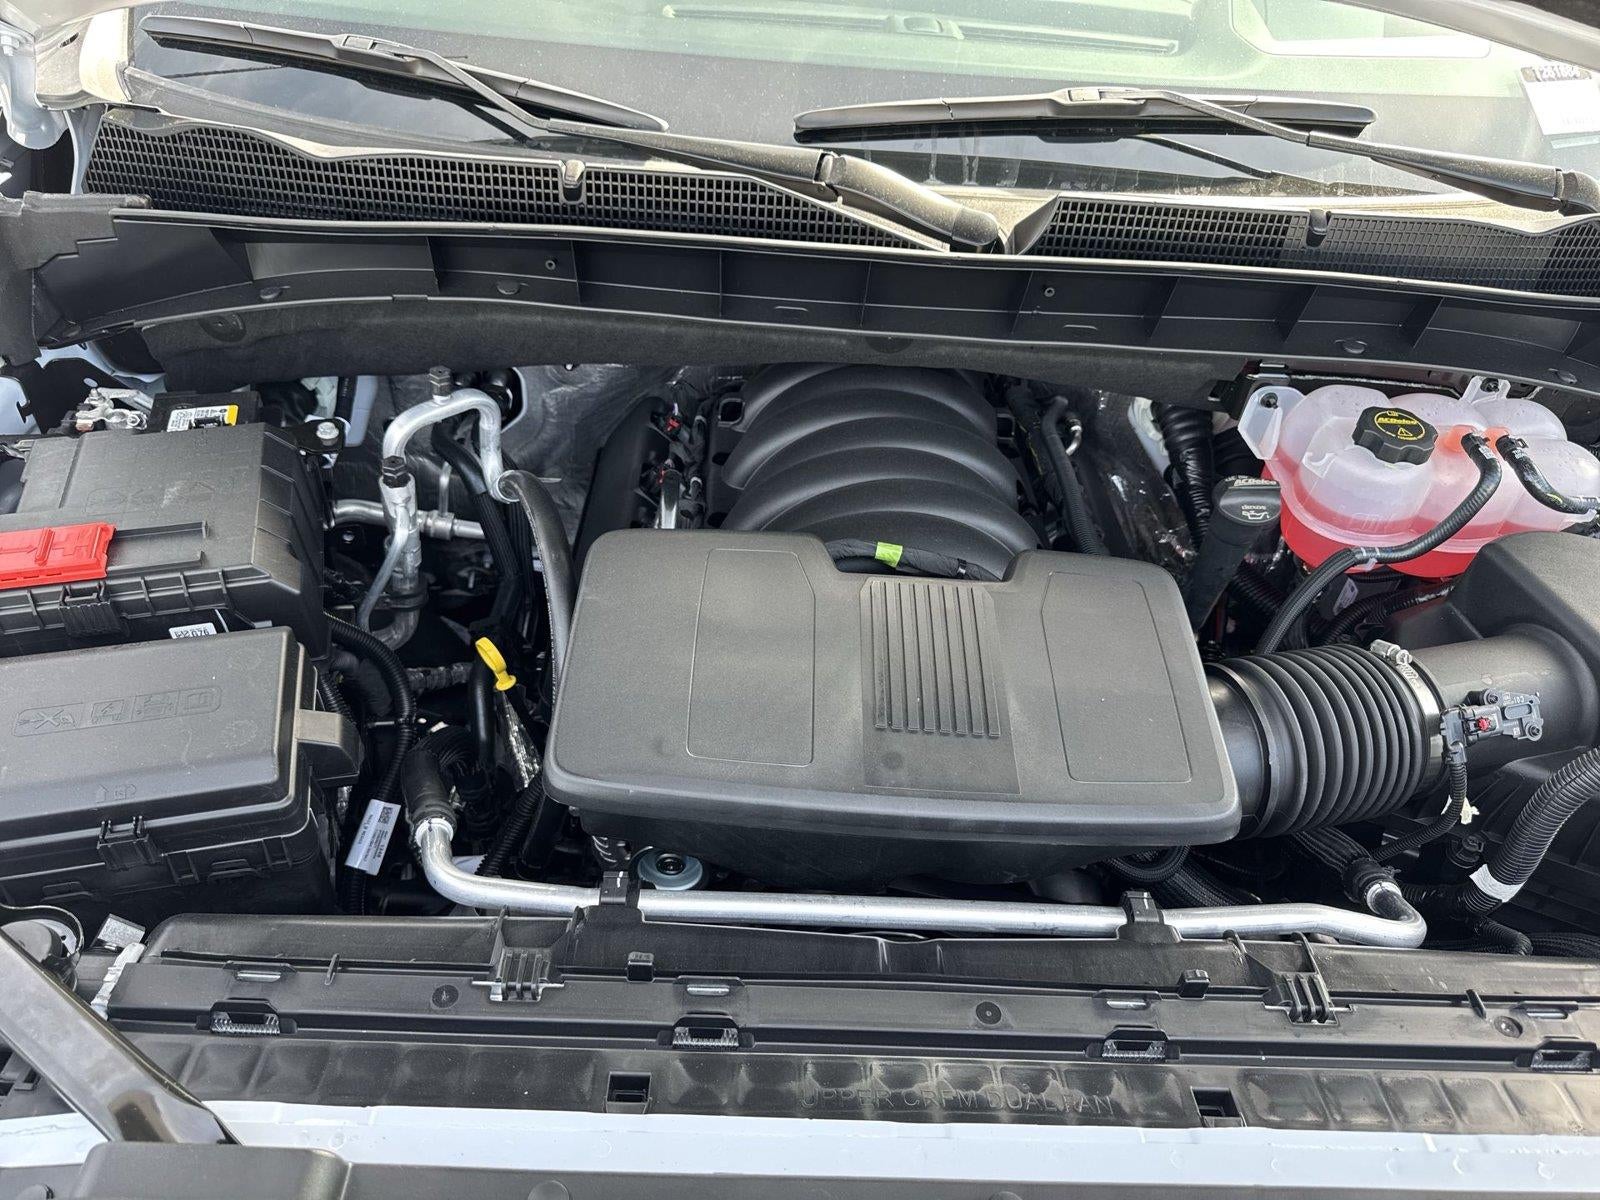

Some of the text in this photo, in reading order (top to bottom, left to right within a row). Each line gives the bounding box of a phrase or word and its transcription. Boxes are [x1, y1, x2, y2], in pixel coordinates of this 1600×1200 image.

[1234, 479, 1277, 487] ACDelco
[801, 1087, 895, 1109] UPPER
[985, 1091, 1059, 1112] DUAL
[1061, 1093, 1116, 1116] FAN
